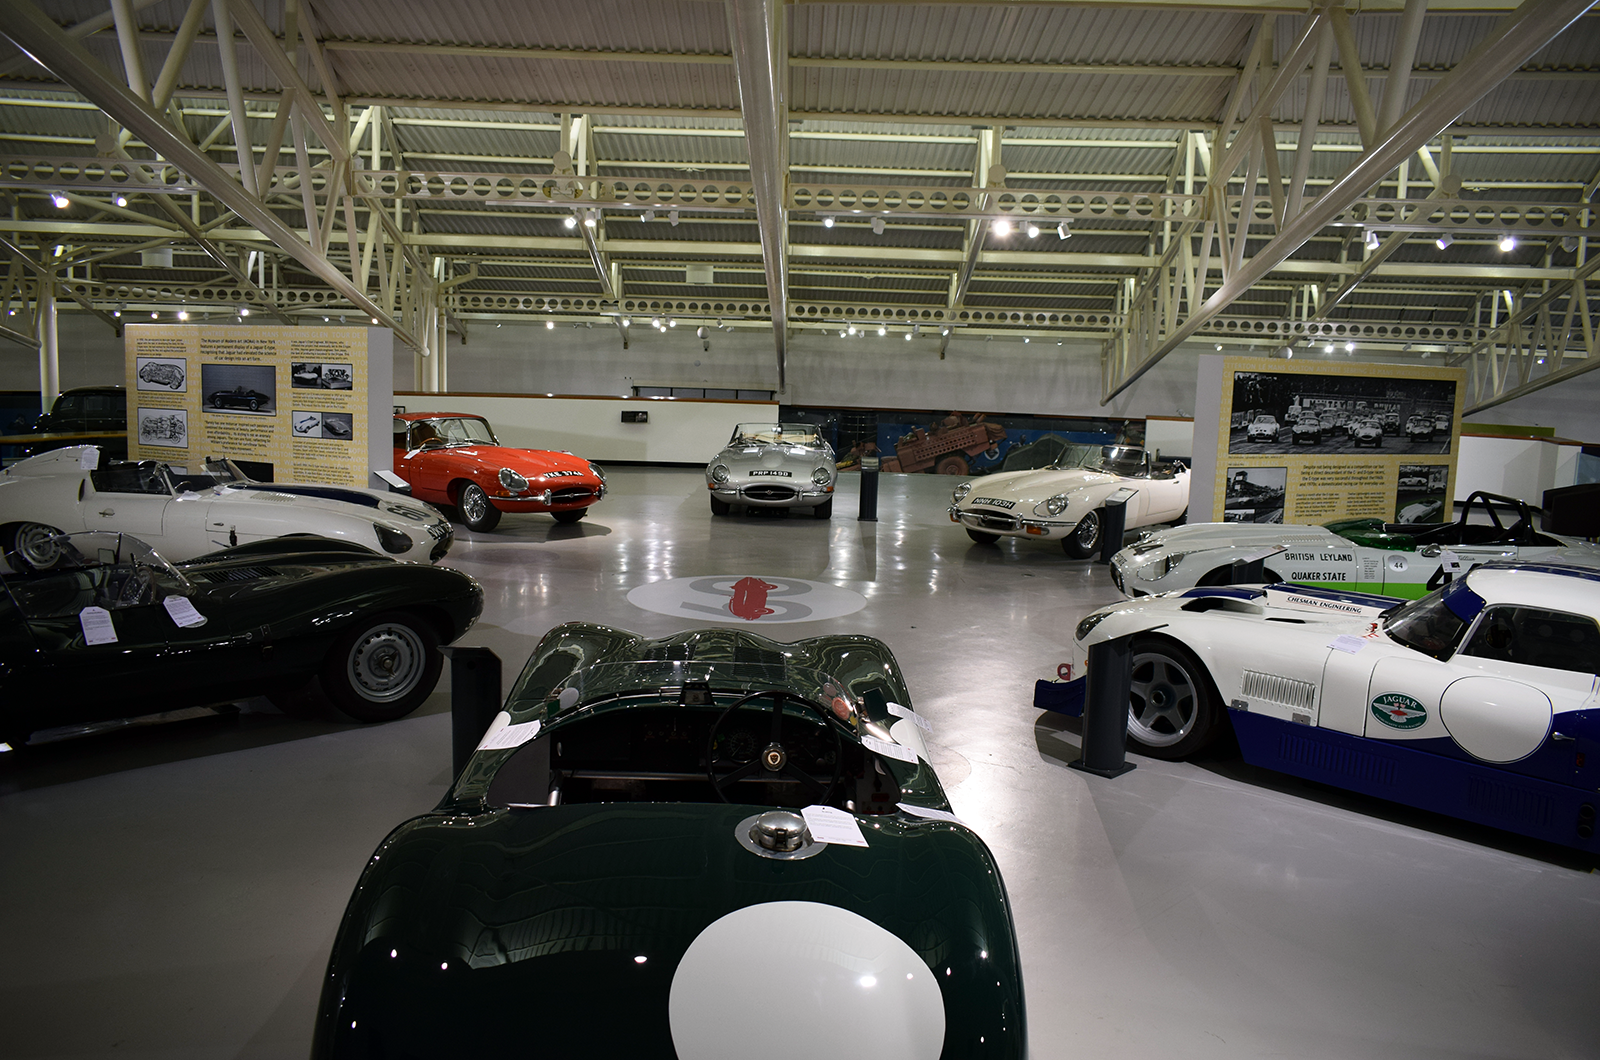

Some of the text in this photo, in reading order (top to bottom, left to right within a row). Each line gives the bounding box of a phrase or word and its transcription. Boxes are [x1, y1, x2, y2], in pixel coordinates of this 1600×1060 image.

[992, 500, 1014, 508] 103H
[1284, 553, 1353, 562] BRITISH LEYLAND
[1291, 571, 1346, 581] QUAKER STATE
[1287, 596, 1362, 614] CHESMAN ENGINEERING
[1383, 695, 1418, 708] JAGUAR
